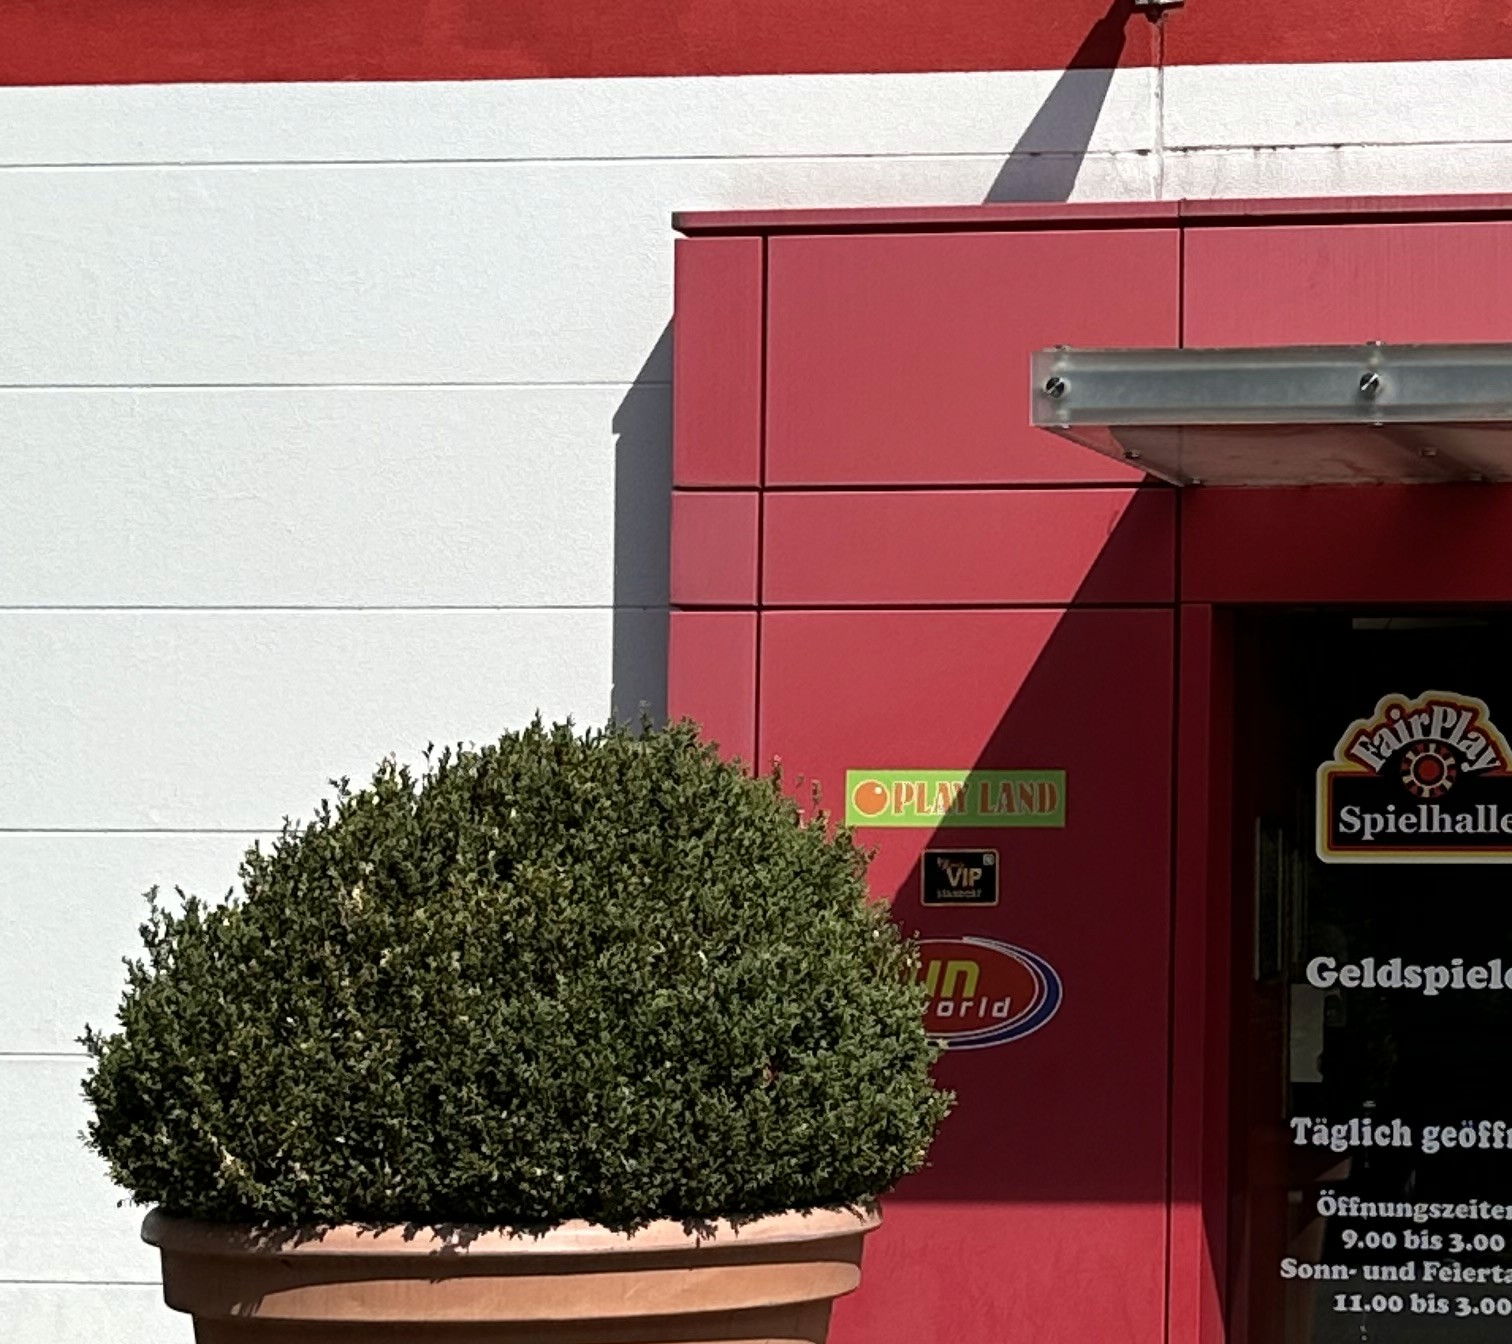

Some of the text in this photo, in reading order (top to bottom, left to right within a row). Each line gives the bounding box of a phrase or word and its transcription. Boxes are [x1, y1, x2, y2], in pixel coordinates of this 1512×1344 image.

[1350, 705, 1501, 773] FairPlay
[891, 780, 1059, 816] PLAY LAND
[946, 867, 982, 887] VIP
[923, 996, 1011, 1018] orld
[1290, 1117, 1412, 1152] Täglich
[1342, 1229, 1505, 1253] 9.00 bis 3.00
[1280, 1258, 1357, 1280] Sonn-
[1363, 1261, 1416, 1282] und
[1333, 1293, 1512, 1317] 11.00 bis 3.00
